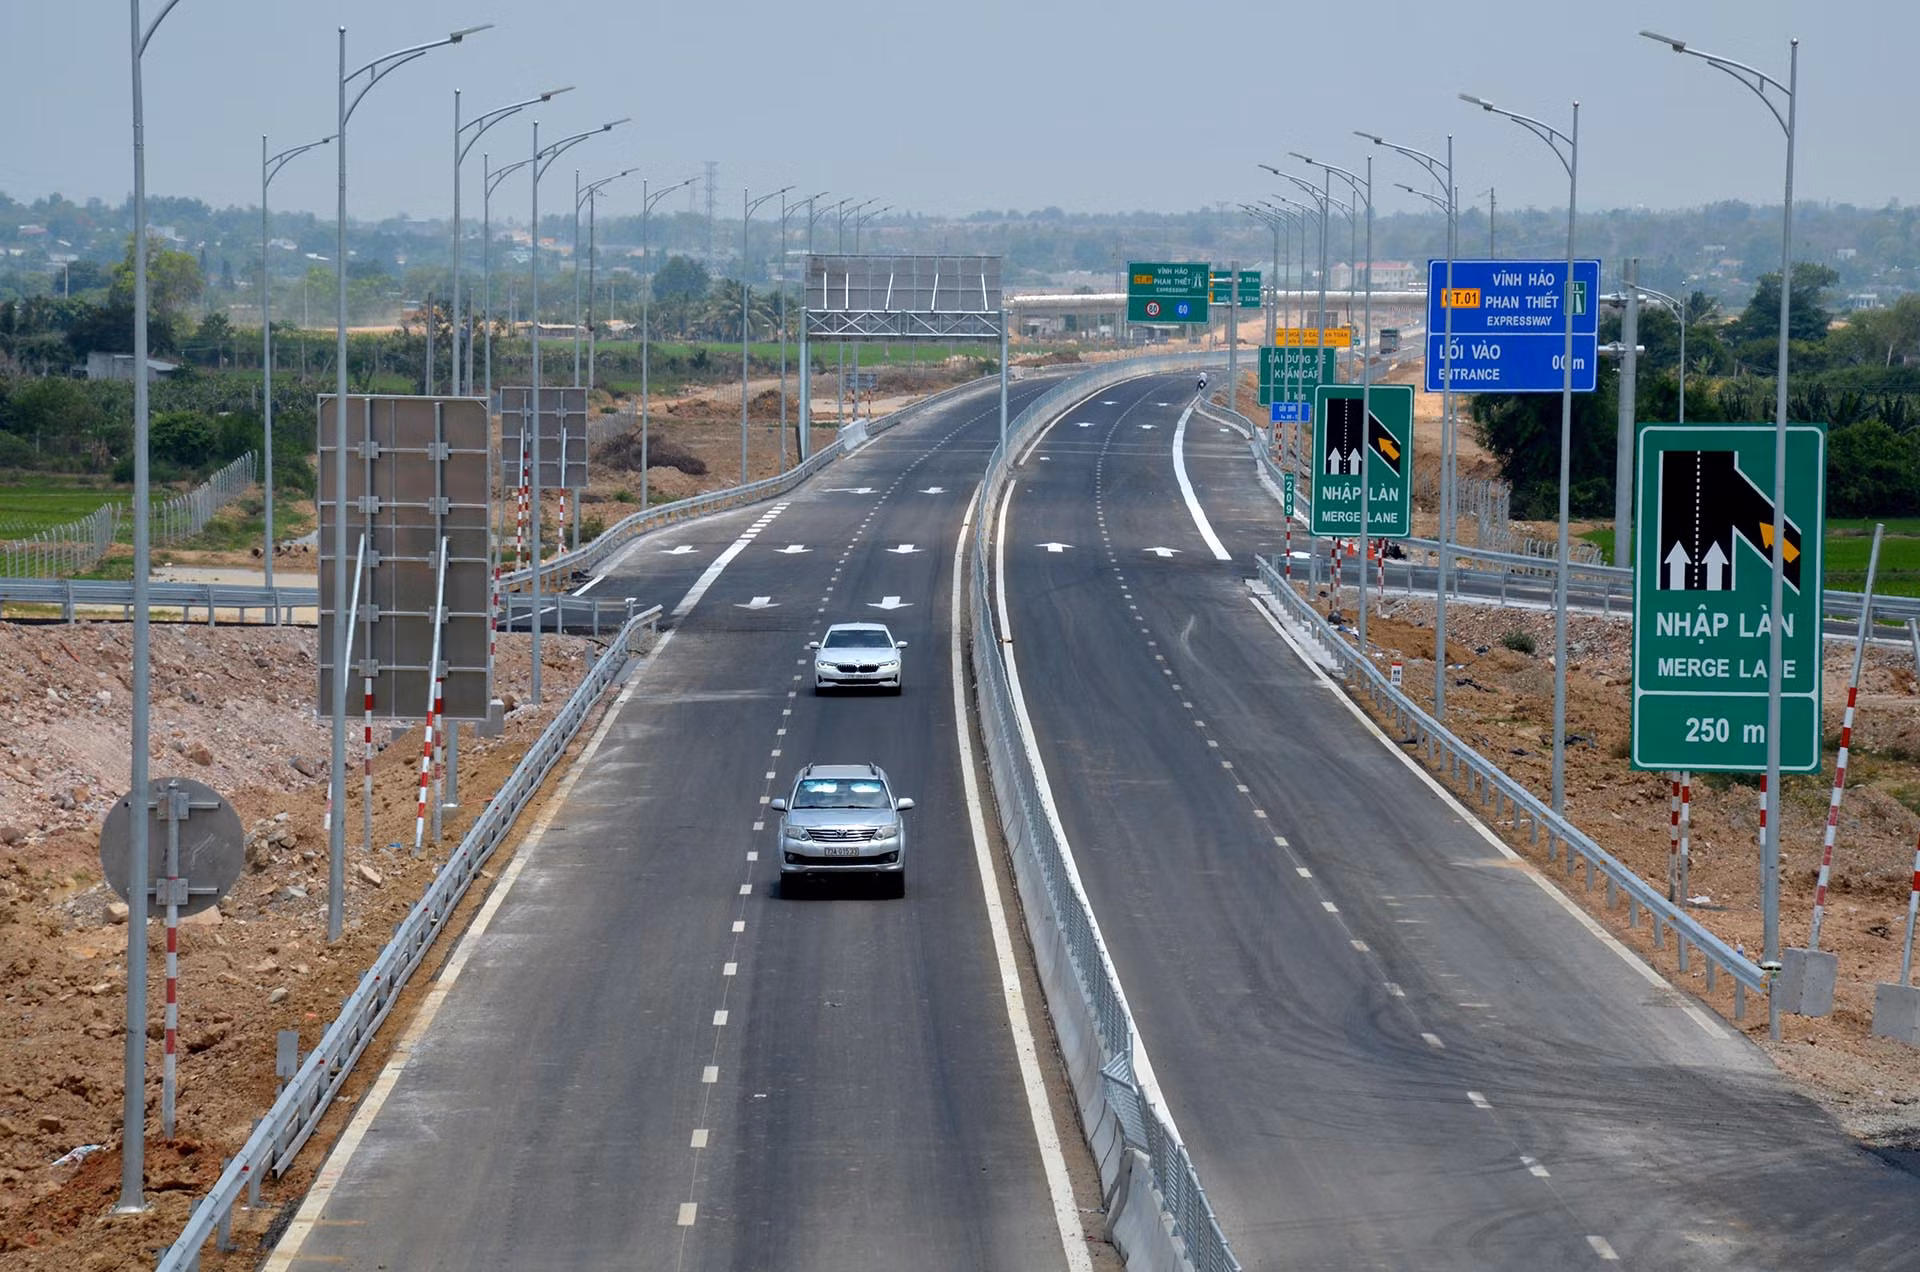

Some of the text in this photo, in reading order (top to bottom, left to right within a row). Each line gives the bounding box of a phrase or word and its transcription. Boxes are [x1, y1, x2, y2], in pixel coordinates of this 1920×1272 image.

[1492, 268, 1555, 287] VĨNH HẢO
[1485, 289, 1559, 309] PHAN THIẾT
[1487, 315, 1552, 326] EXPRESSWAY
[1439, 336, 1501, 360] LỐI VÀO
[1572, 358, 1585, 370] m
[1322, 482, 1399, 504] NHẬP LÀN
[1322, 510, 1398, 524] MERGE LANE
[1656, 603, 1794, 645] NHẬP LÀN
[1657, 657, 1796, 679] MERGE LAE
[1685, 717, 1765, 744] 250 m
